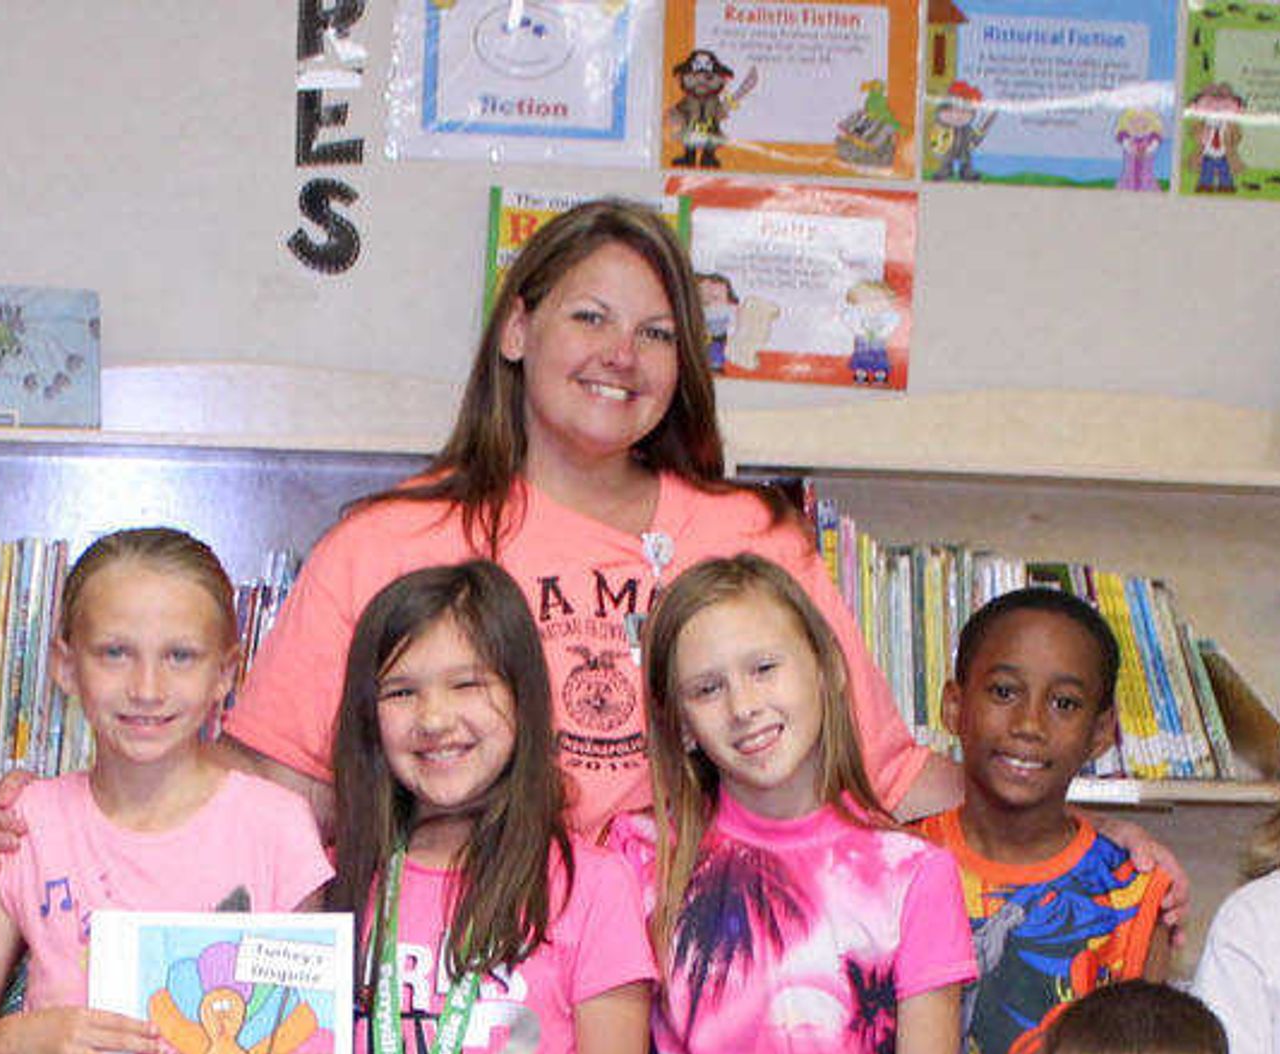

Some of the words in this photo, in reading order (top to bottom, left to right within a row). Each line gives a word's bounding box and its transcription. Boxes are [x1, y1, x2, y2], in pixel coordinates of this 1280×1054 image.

[723, 4, 795, 26] Realistic
[801, 10, 862, 29] Fiction
[983, 24, 1064, 47] Historical
[1067, 30, 1126, 49] Fiction
[479, 93, 570, 119] fiction
